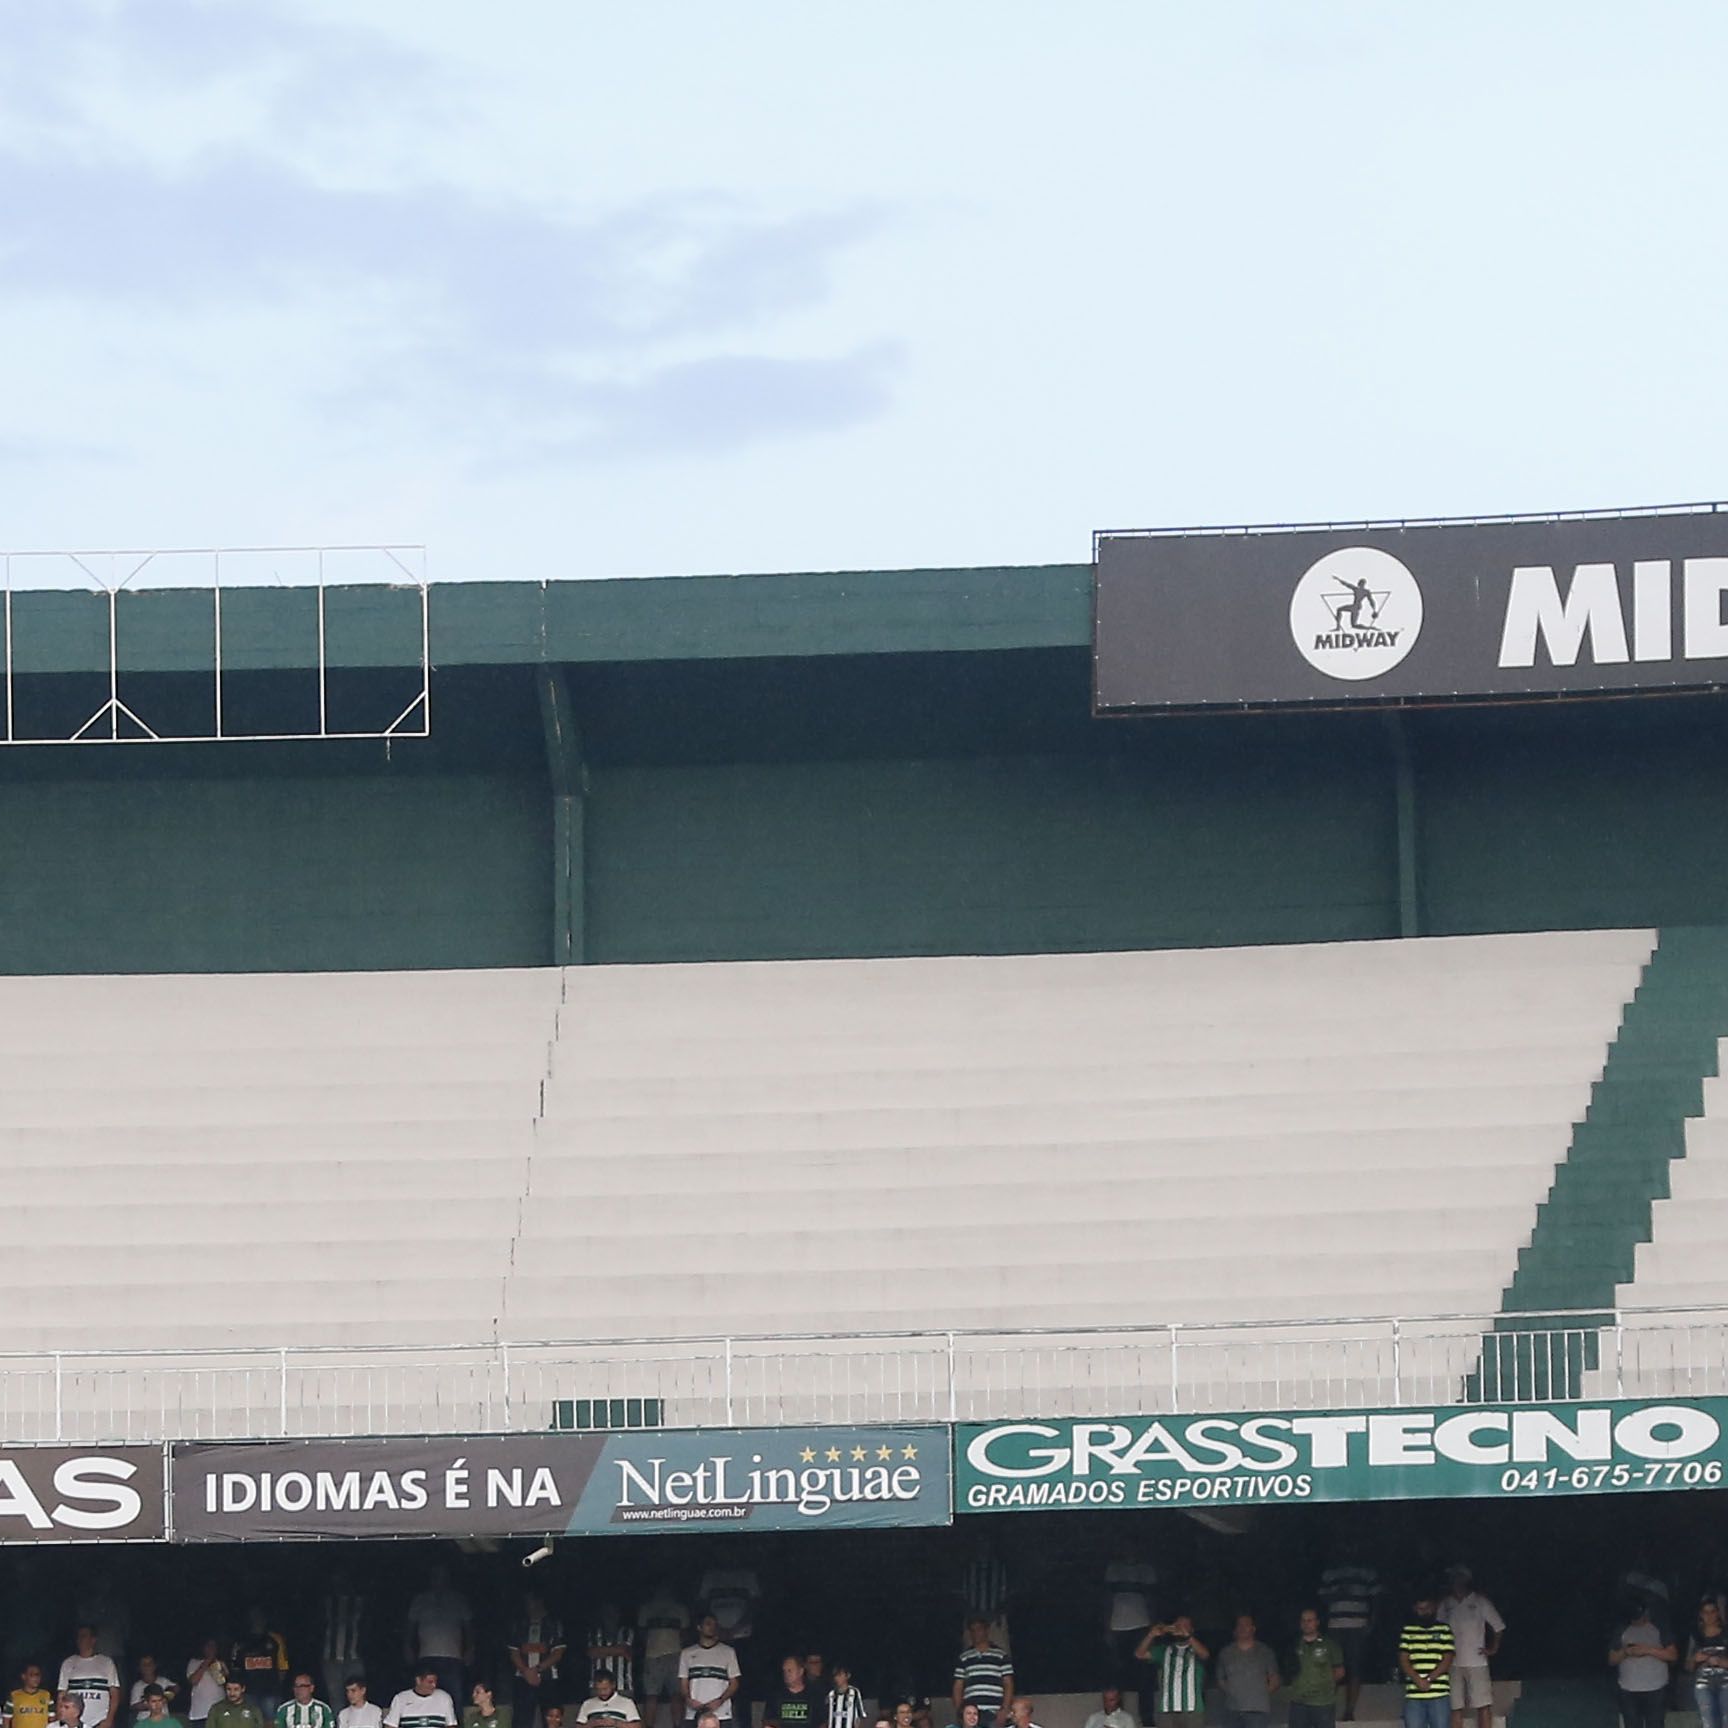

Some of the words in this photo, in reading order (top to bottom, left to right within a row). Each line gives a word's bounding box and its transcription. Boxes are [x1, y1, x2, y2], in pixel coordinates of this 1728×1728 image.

[1314, 630, 1400, 650] MIDWAY
[966, 1406, 1721, 1476] GRASSTECNO
[205, 1467, 427, 1513] IDIOMAS
[445, 1455, 469, 1510] É
[486, 1466, 561, 1508] NA
[616, 1454, 920, 1515] NetLinguae
[966, 1481, 1125, 1506] GRAMADOS
[1136, 1474, 1312, 1502] ESPORTIVOS
[1500, 1461, 1722, 1492] 041-675-7706
[622, 1507, 747, 1521] www.netlinguae.com.br
[79, 1692, 101, 1700] AIXA
